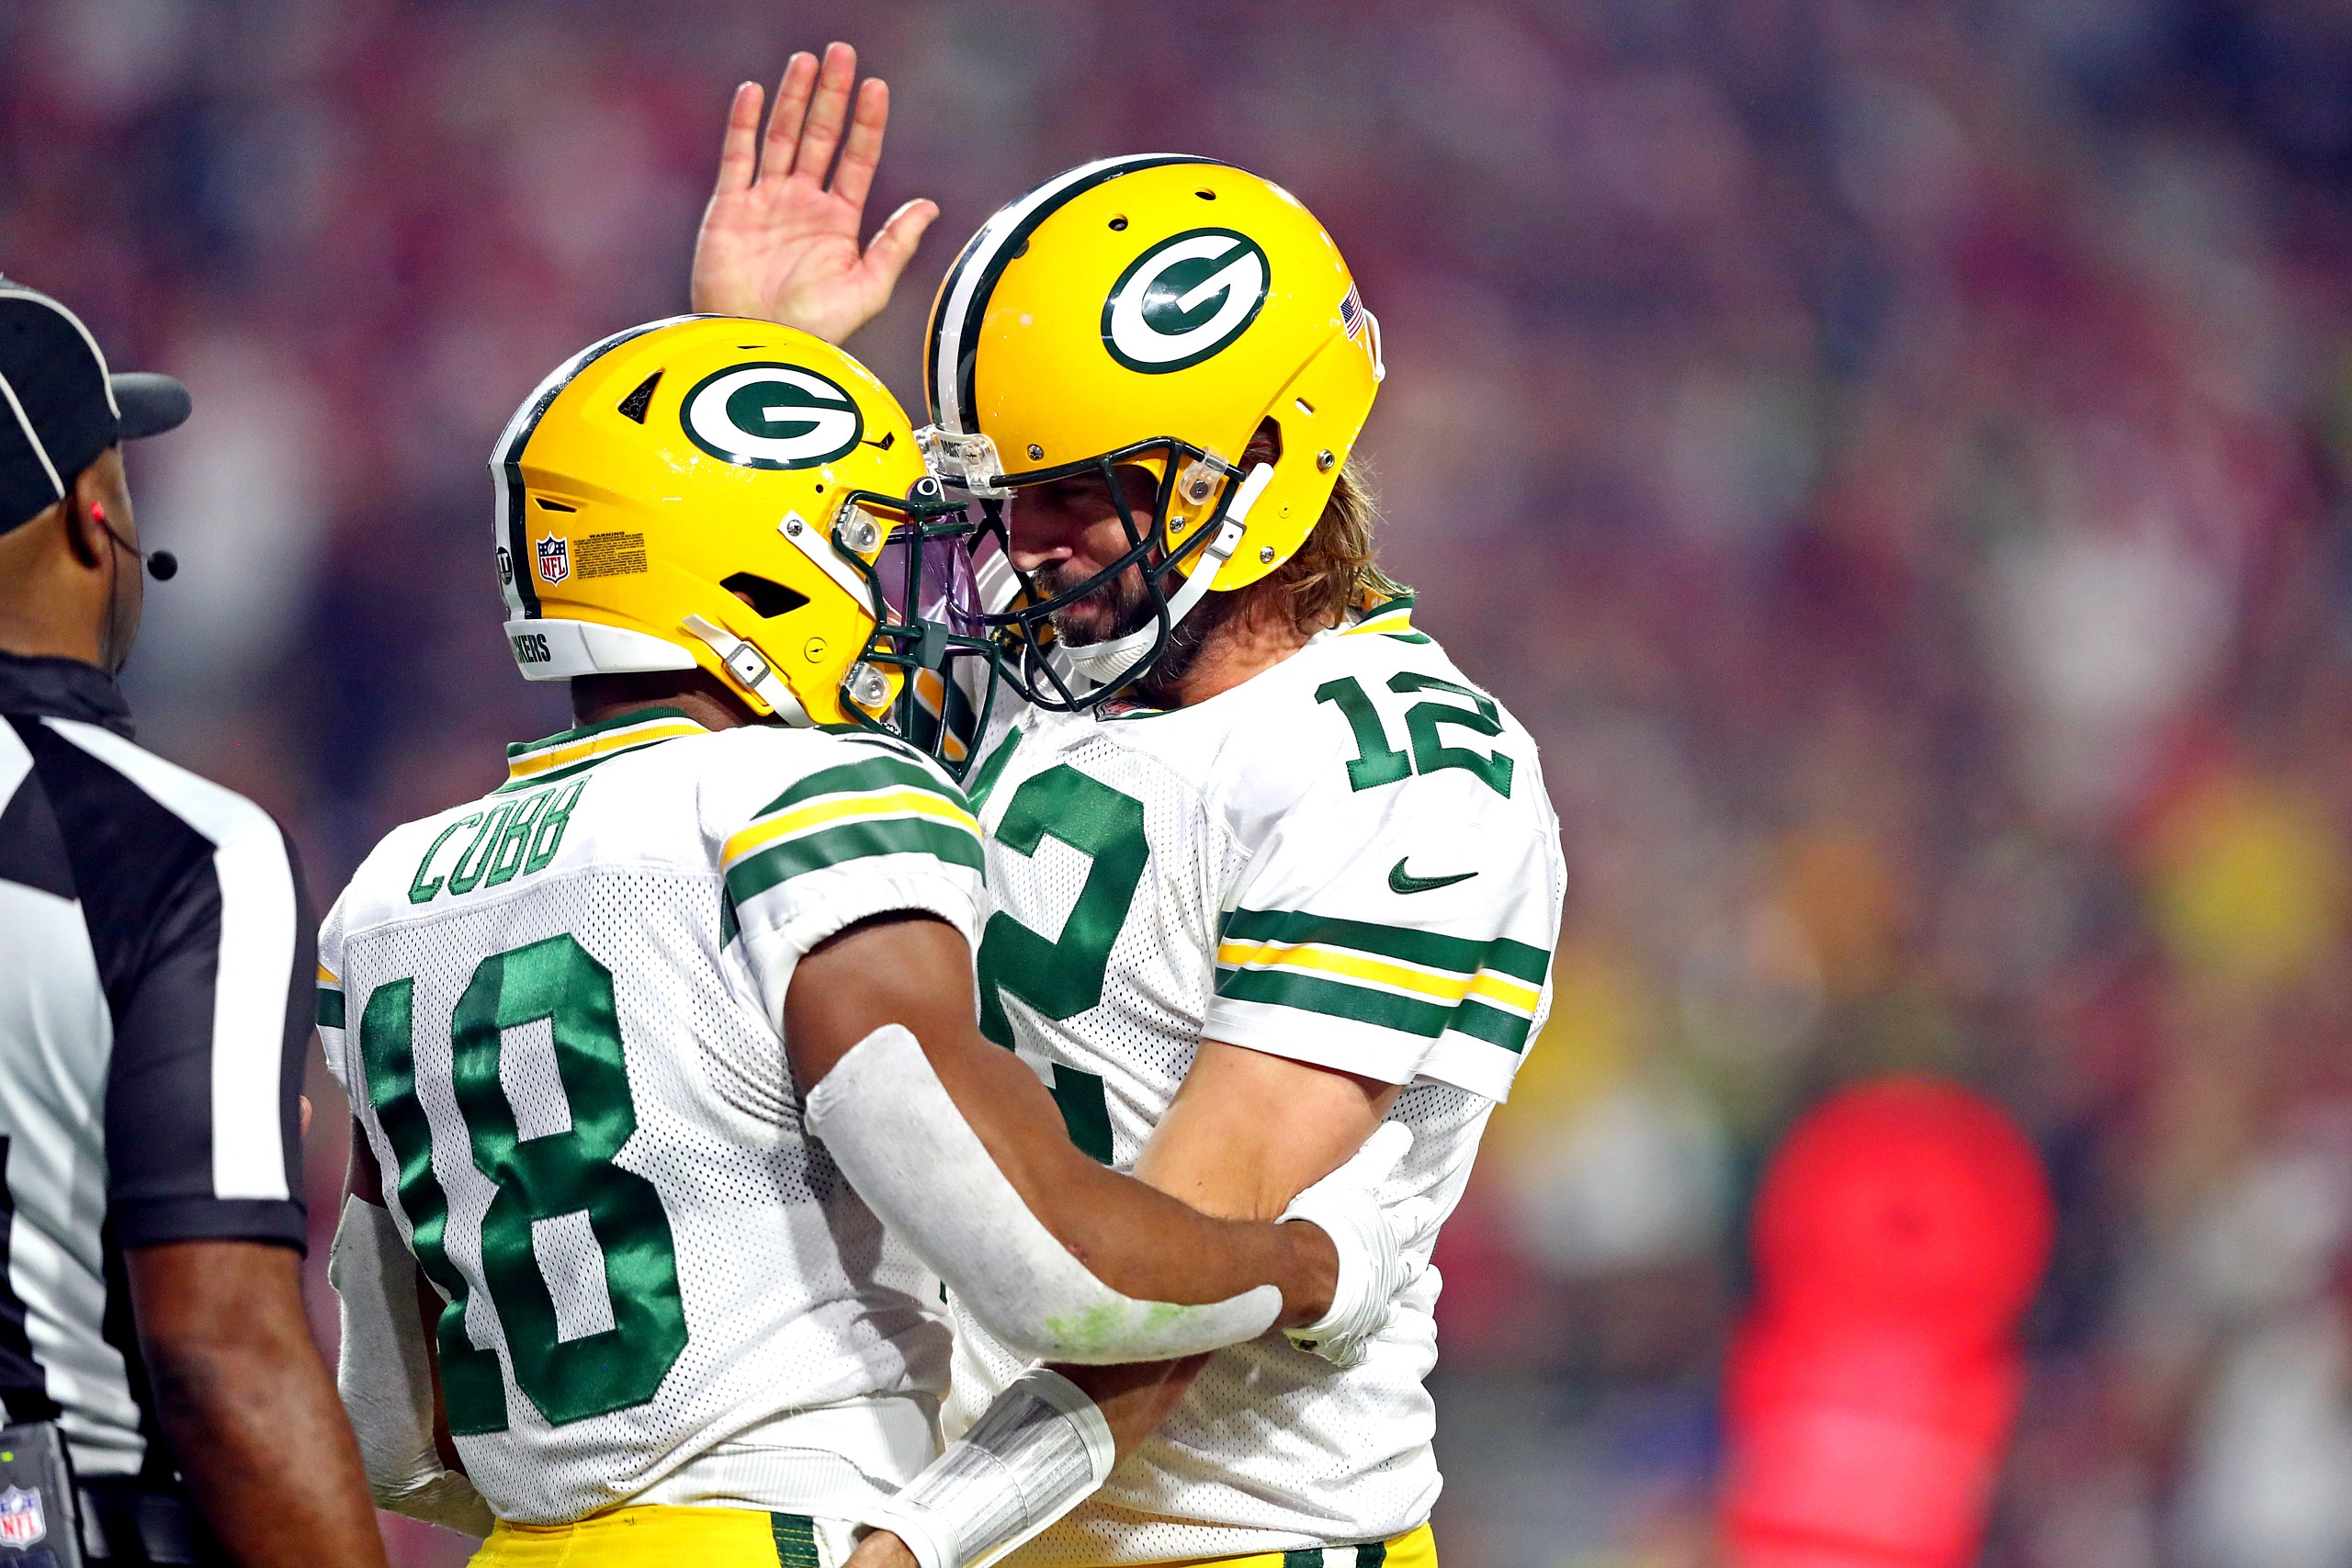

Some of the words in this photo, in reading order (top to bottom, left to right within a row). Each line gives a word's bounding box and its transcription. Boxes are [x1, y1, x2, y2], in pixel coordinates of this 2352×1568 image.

[1112, 234, 1264, 364] G
[689, 367, 857, 462] G
[542, 556, 566, 579] NFL
[511, 633, 551, 664] KERS
[1314, 671, 1515, 800] 12
[407, 774, 593, 905] COBB
[967, 725, 1150, 1168] 2
[360, 931, 689, 1437] 18
